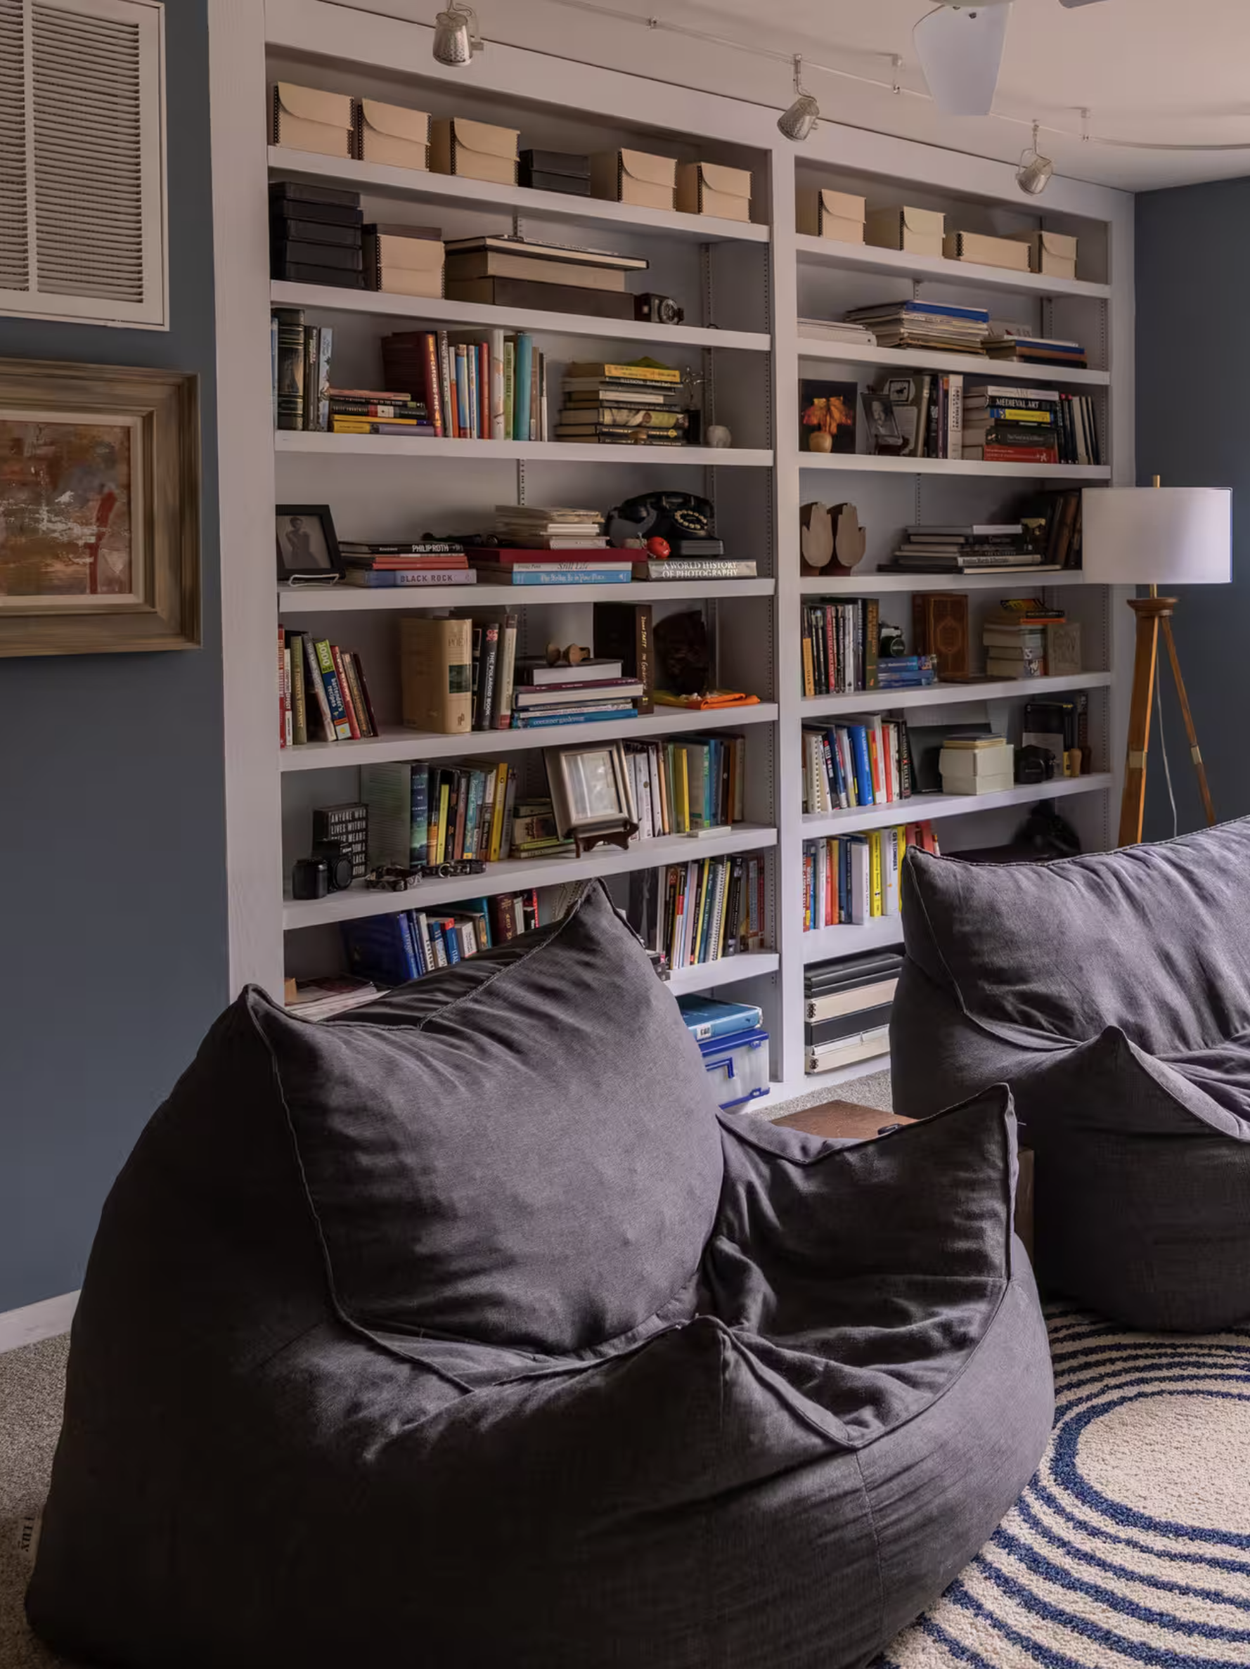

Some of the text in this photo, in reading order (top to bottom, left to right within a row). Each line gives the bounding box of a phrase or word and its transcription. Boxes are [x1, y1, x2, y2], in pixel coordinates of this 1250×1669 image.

[995, 398, 1039, 409] MEDIEVAL ART
[411, 544, 449, 553] PHILIP ROTH
[400, 574, 453, 583] BLACK ROCK
[676, 569, 738, 578] PHOTOGRAPHY
[319, 642, 331, 666] 1000
[486, 665, 494, 697] POLAROID
[327, 685, 336, 708] recipes
[330, 678, 344, 712] bartender's
[331, 808, 366, 823] ANYONE WHO
[331, 820, 366, 835] LIVES WITHIN
[348, 832, 366, 842] MEANS
[352, 854, 366, 864] LACK
